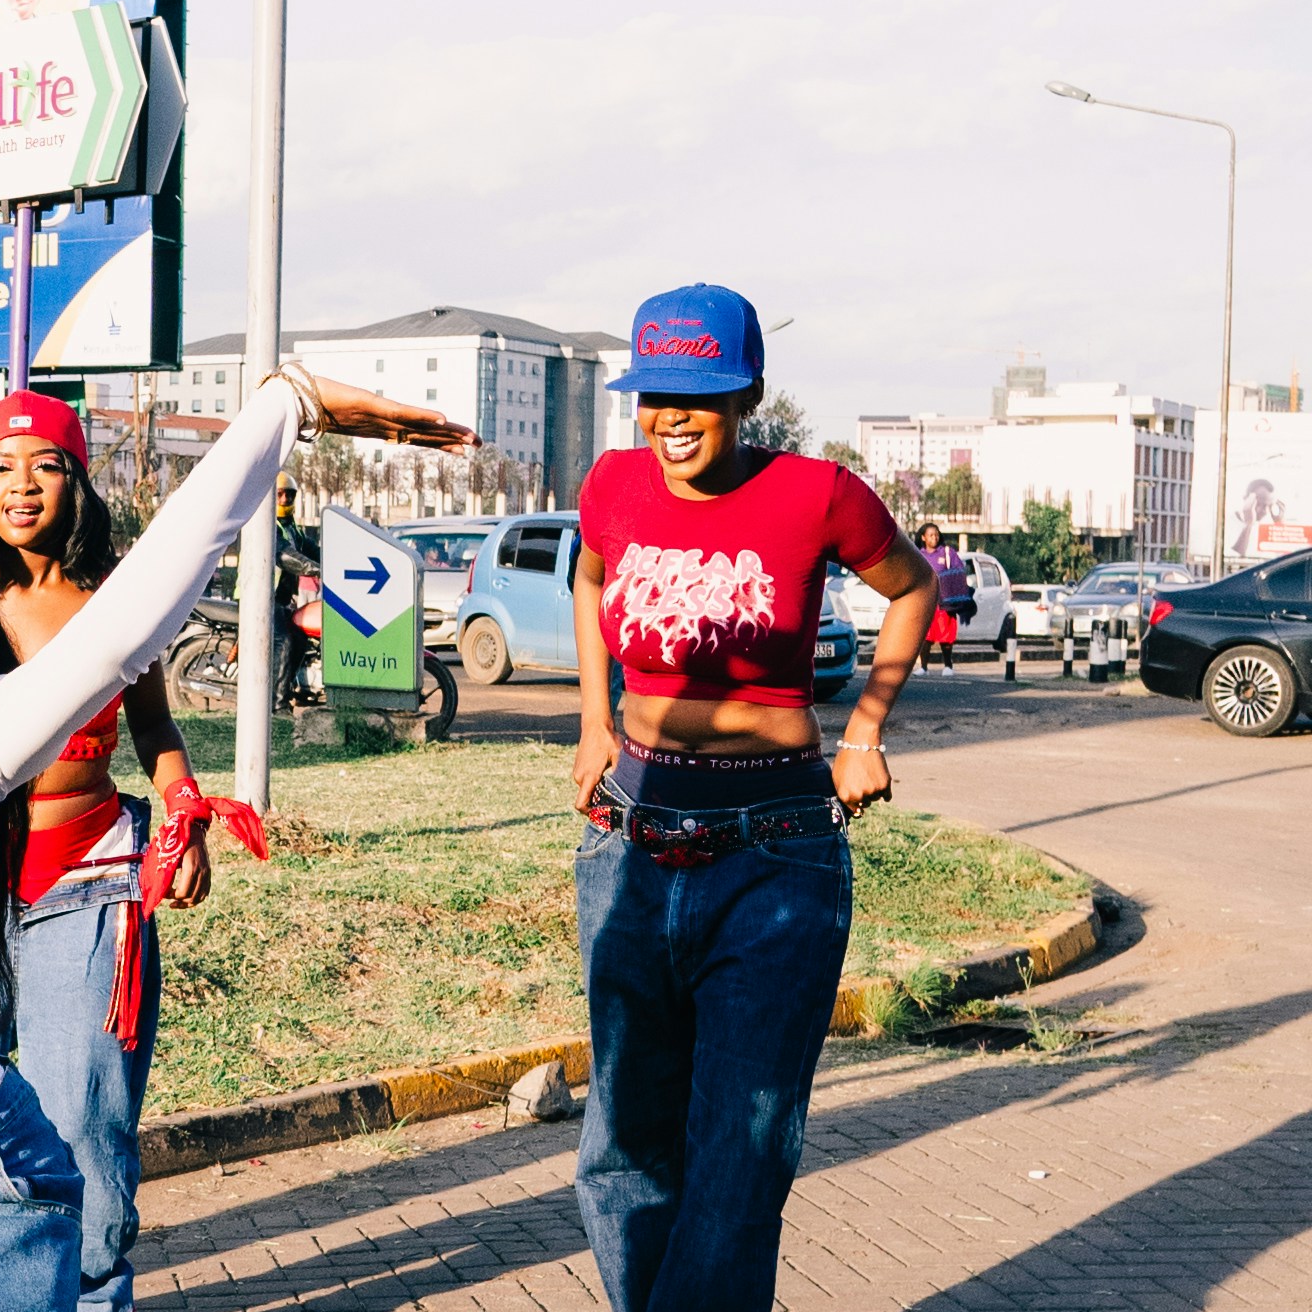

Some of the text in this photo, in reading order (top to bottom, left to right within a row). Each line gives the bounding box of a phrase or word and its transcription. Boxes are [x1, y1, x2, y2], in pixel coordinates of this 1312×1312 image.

[25, 134, 65, 149] Beauty
[637, 321, 722, 358] Giants
[626, 581, 735, 618] LESS
[339, 650, 397, 673] Way in
[629, 741, 681, 765] HILFIGER
[709, 757, 776, 769] TOMMY
